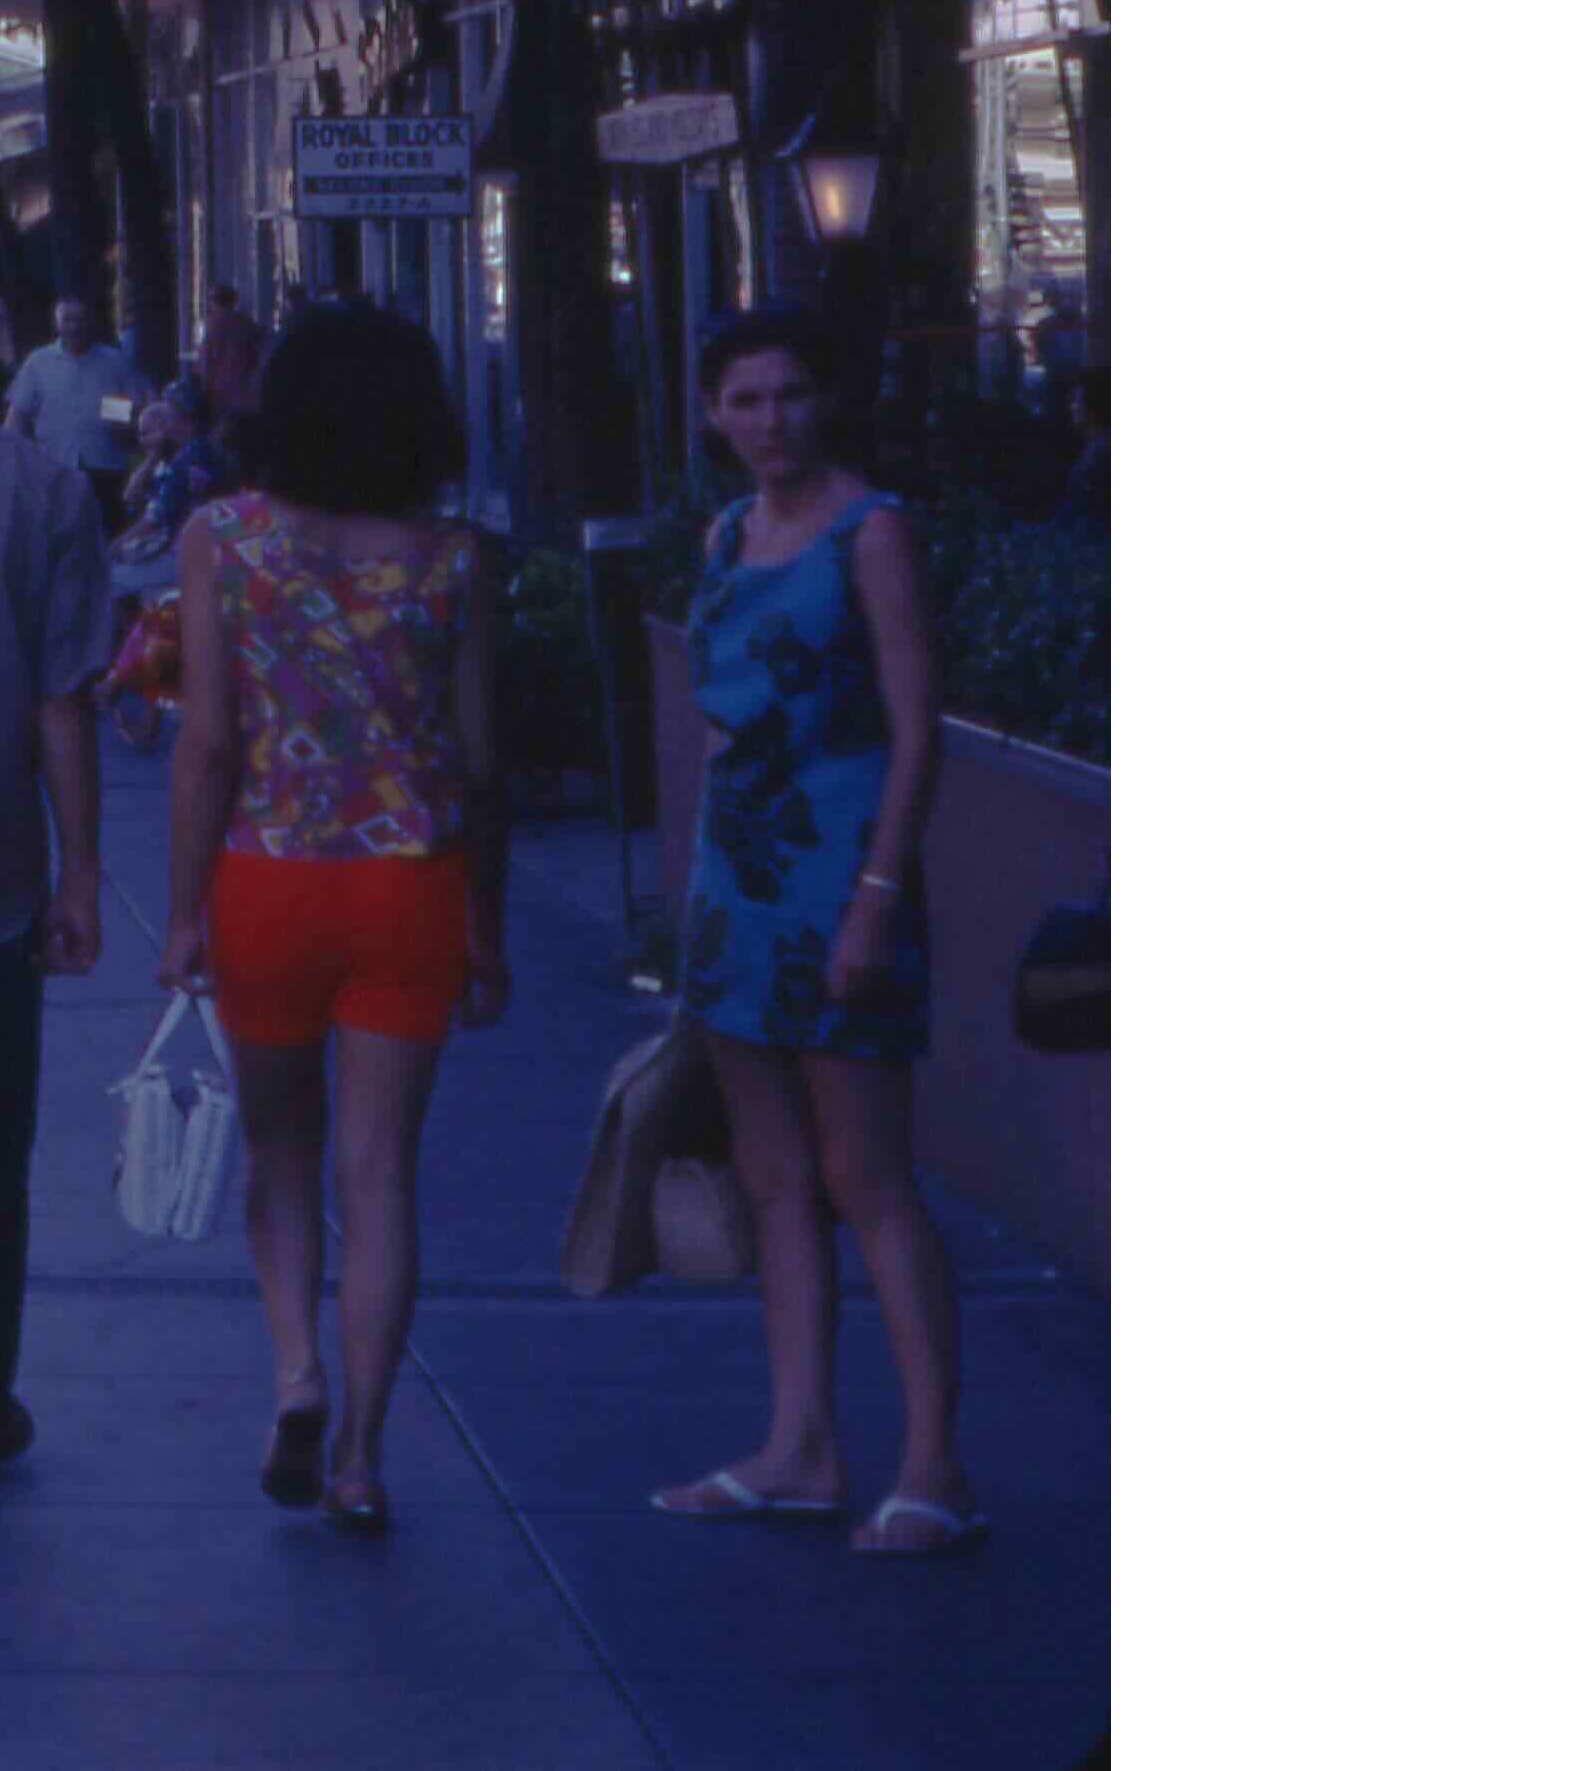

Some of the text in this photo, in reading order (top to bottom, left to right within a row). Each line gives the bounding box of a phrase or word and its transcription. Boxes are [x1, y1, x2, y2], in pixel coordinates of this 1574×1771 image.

[301, 122, 466, 148] ROYAL BLOCK
[334, 151, 435, 170] OFFICES
